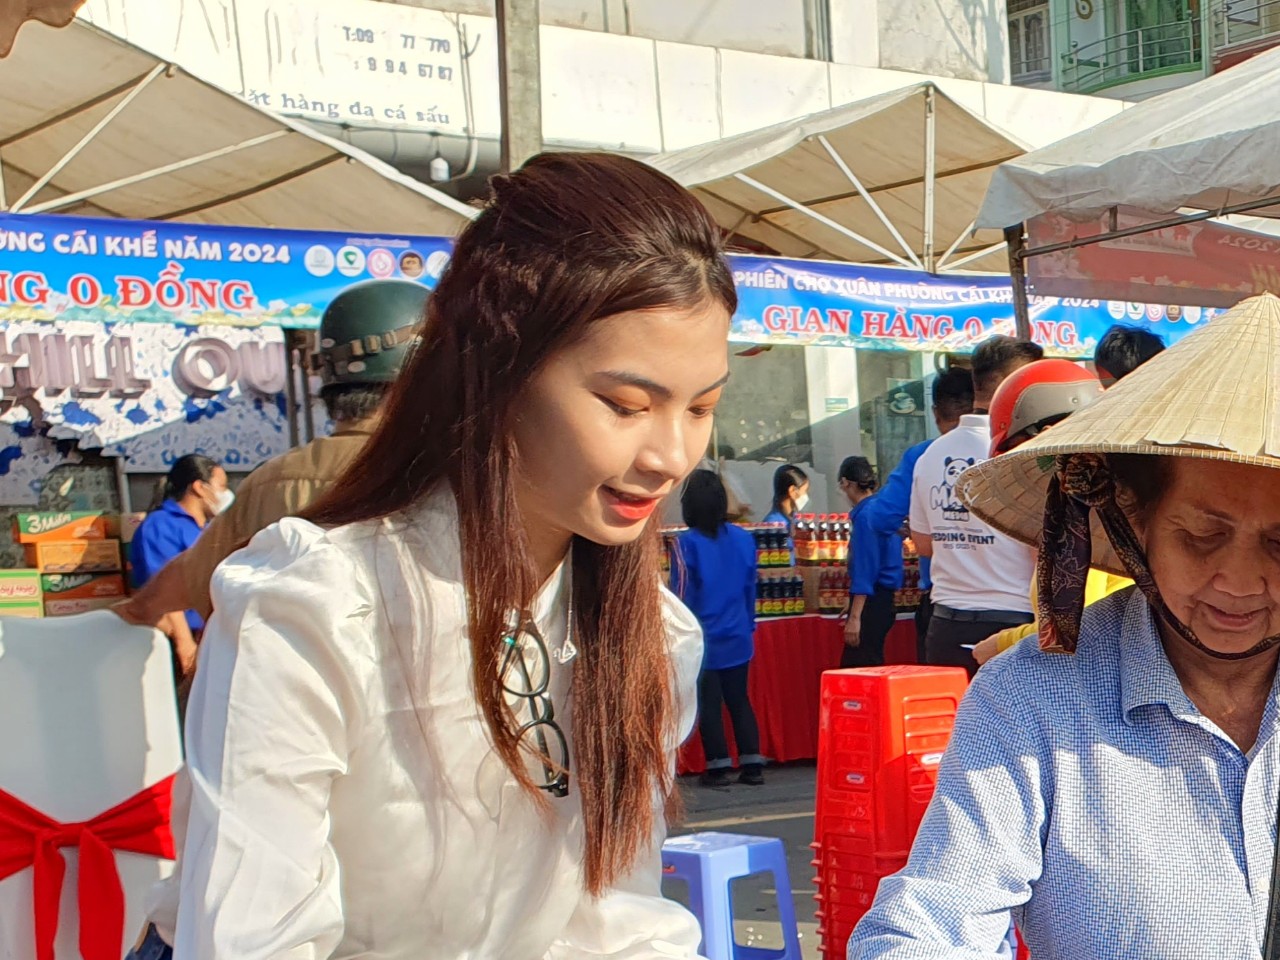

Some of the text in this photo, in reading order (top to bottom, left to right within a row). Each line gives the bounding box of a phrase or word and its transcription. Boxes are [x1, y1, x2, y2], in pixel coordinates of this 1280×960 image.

[282, 93, 340, 118] hàng
[384, 104, 406, 121] cá
[416, 105, 450, 124] sấu
[54, 230, 98, 257] CÁI
[105, 231, 158, 259] KHẾ
[164, 236, 222, 262] NĂM
[228, 243, 291, 264] 2024
[117, 262, 254, 311] ĐỒNG
[734, 269, 789, 290] PHIÊN
[794, 274, 832, 295] CHỢ
[831, 275, 883, 297] XUÂN
[884, 280, 954, 302] PHƯỜNG
[763, 305, 848, 335] GIAN
[864, 306, 955, 341] HÀNG
